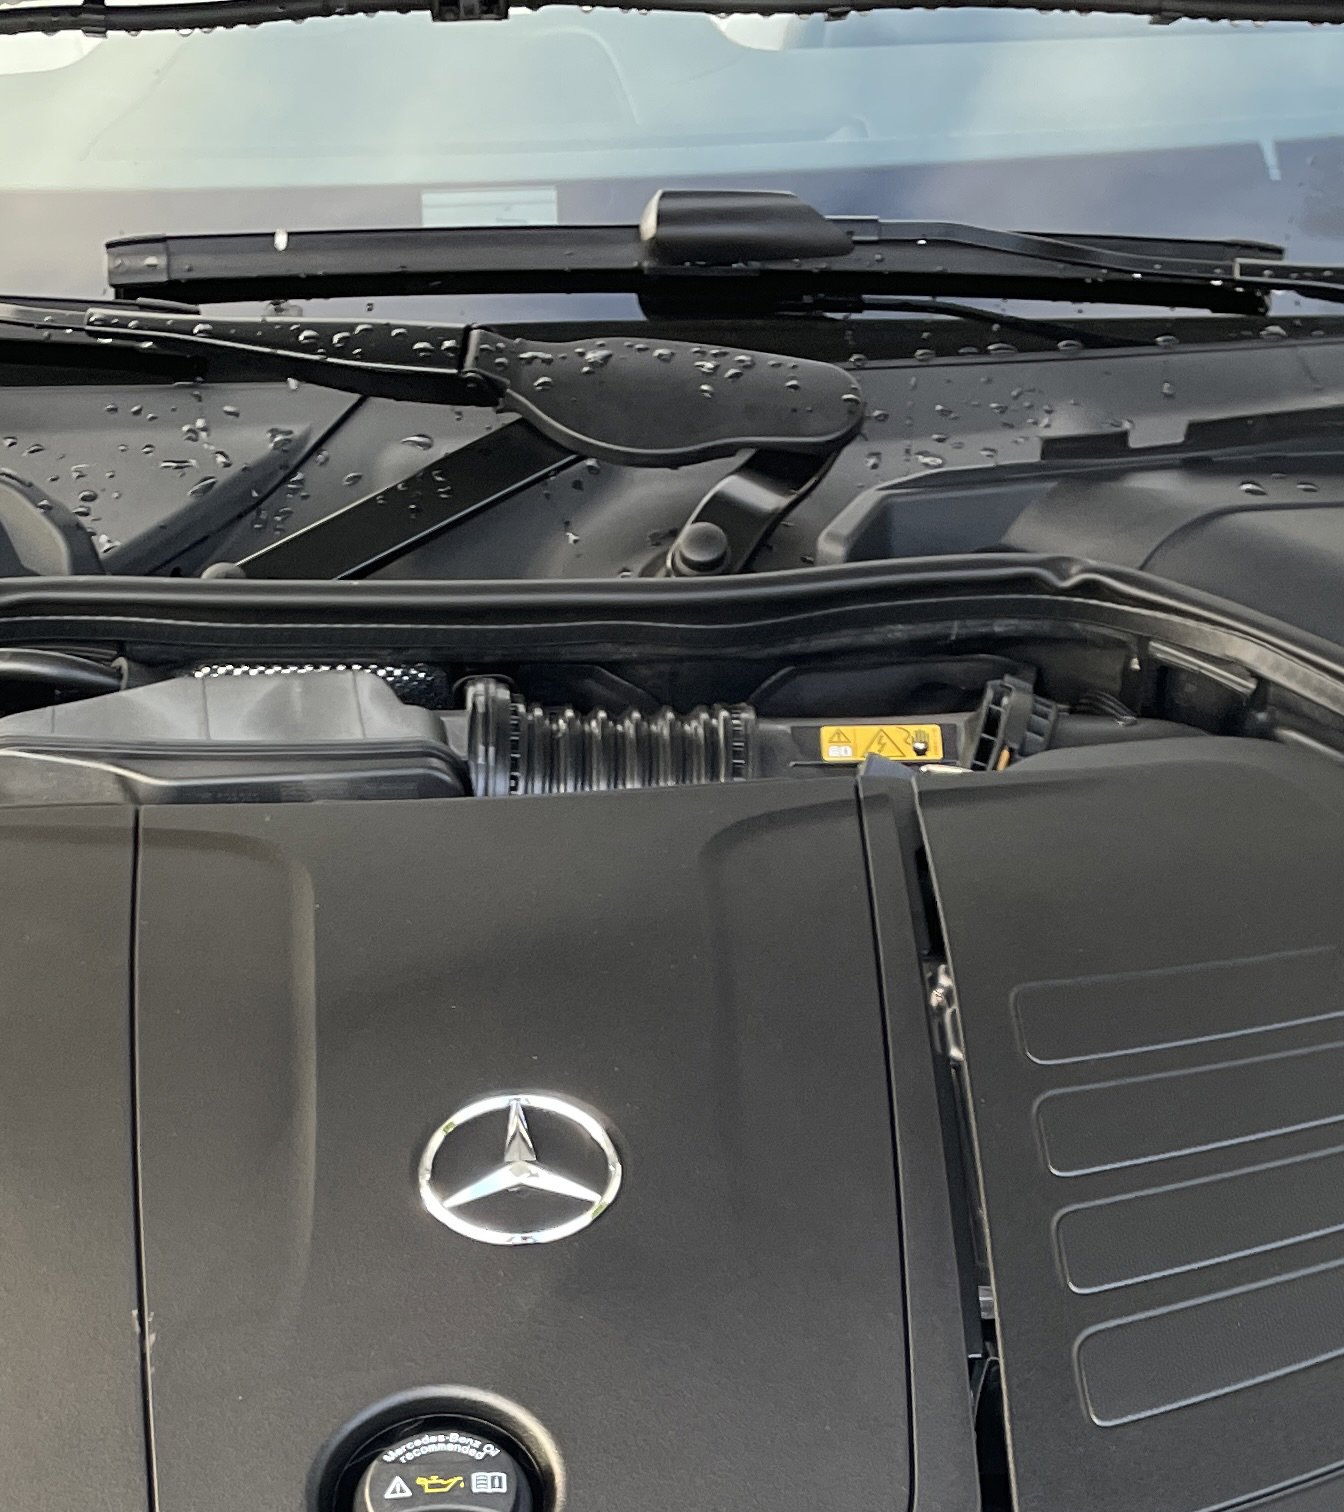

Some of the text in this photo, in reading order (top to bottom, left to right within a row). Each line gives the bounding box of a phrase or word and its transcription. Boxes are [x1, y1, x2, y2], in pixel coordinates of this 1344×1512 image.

[382, 1432, 501, 1462] Mercedes-Benz Oil
[399, 1442, 486, 1463] recommended
